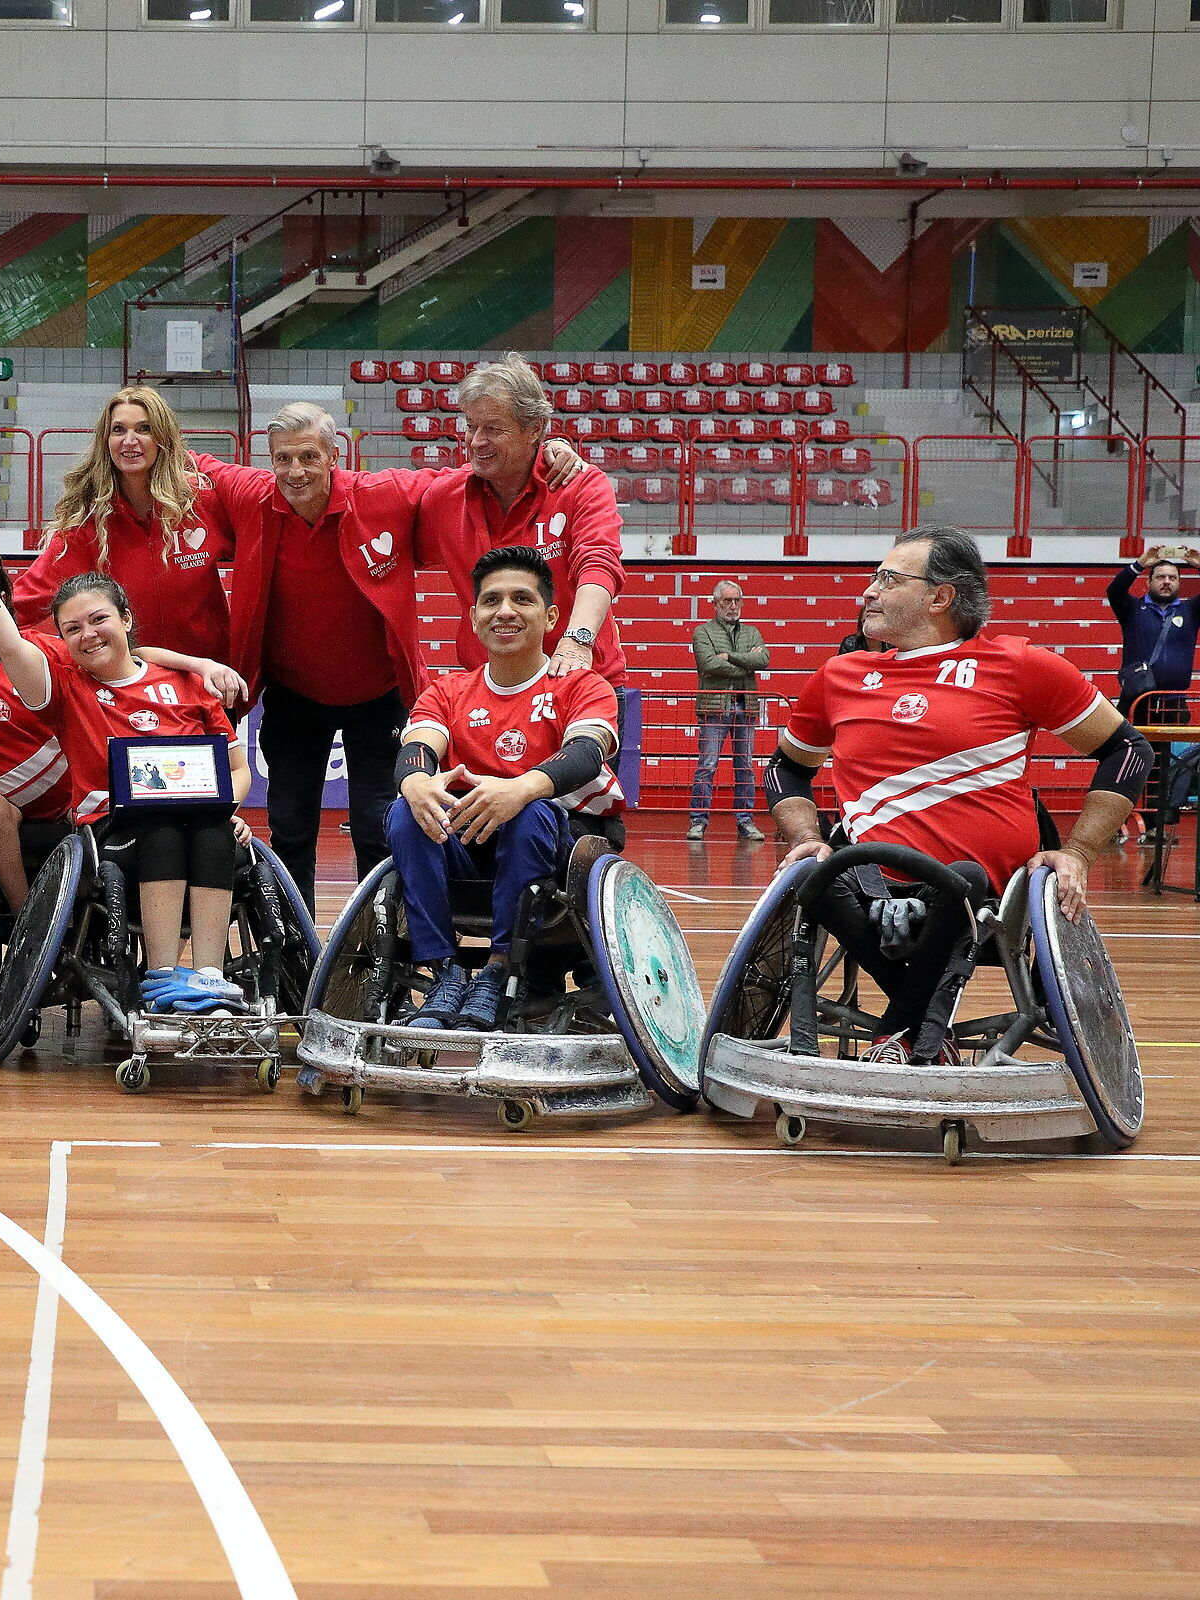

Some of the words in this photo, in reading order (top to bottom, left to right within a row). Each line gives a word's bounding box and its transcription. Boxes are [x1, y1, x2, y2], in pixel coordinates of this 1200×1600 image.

[172, 530, 183, 555] I
[535, 522, 546, 546] I
[934, 658, 978, 688] 26
[143, 683, 179, 705] 19
